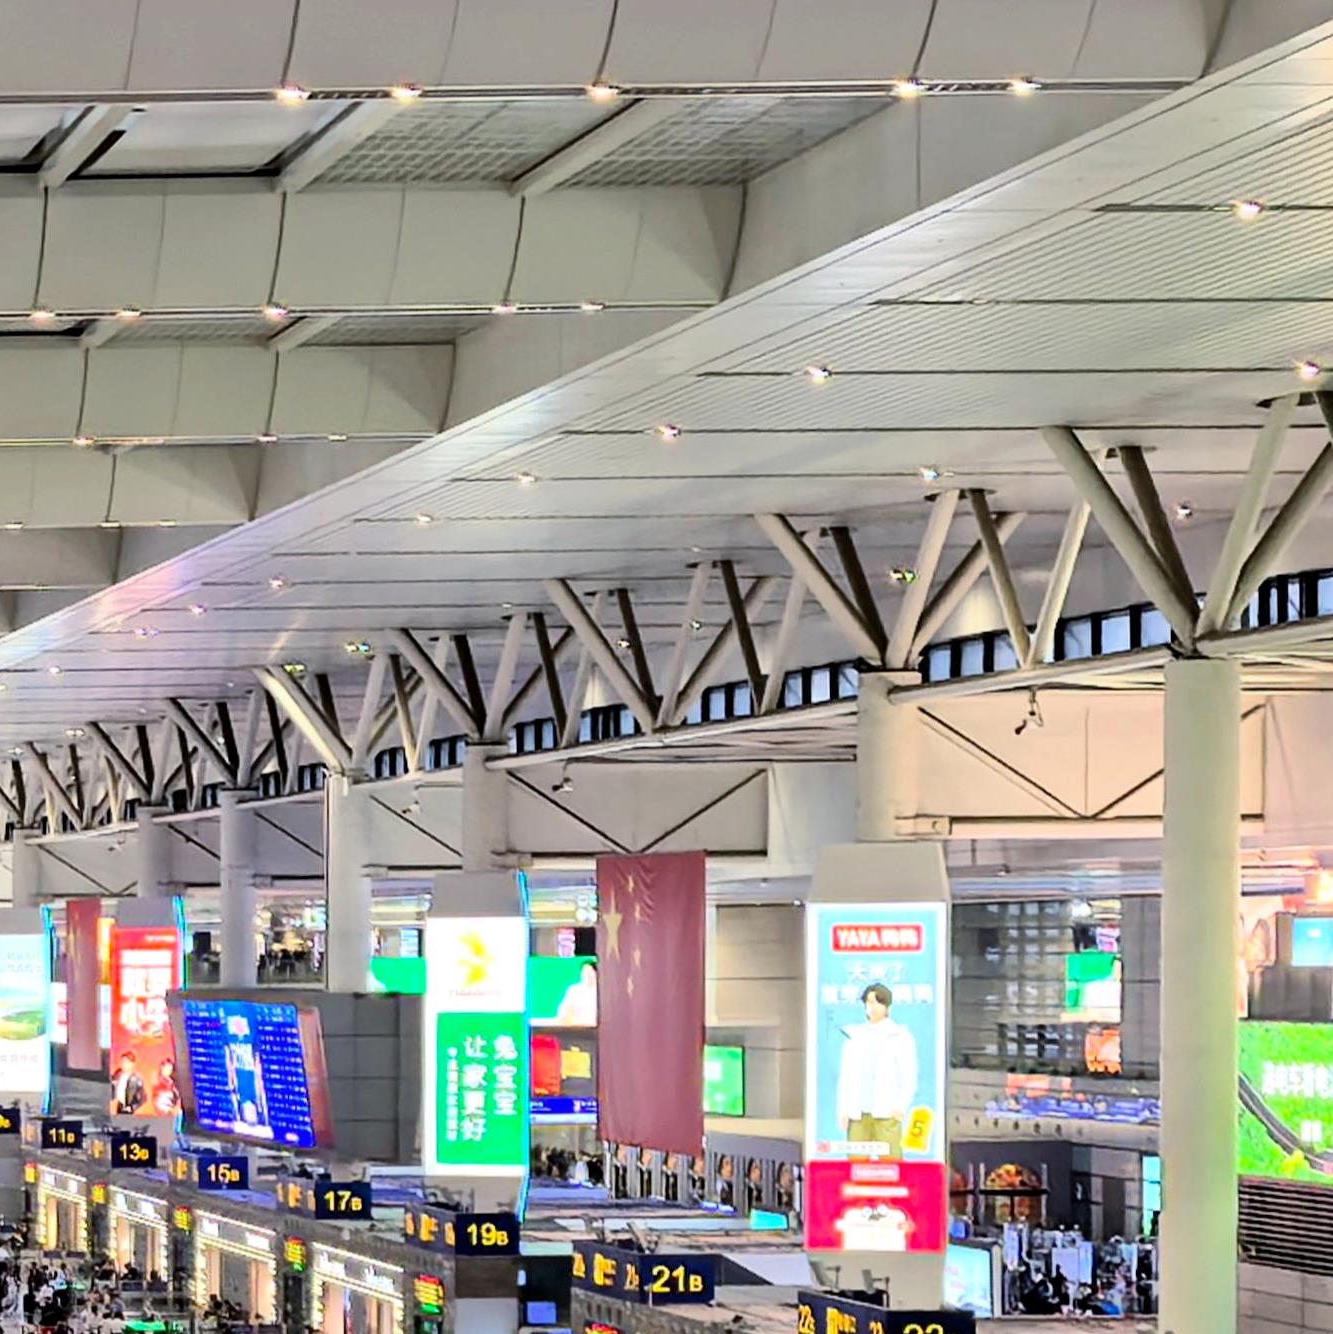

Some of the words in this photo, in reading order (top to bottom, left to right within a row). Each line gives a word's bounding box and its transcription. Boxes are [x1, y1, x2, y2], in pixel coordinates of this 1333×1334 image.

[324, 1190, 363, 1211] 17B
[466, 1223, 509, 1246] 19B
[652, 1265, 703, 1293] 21B
